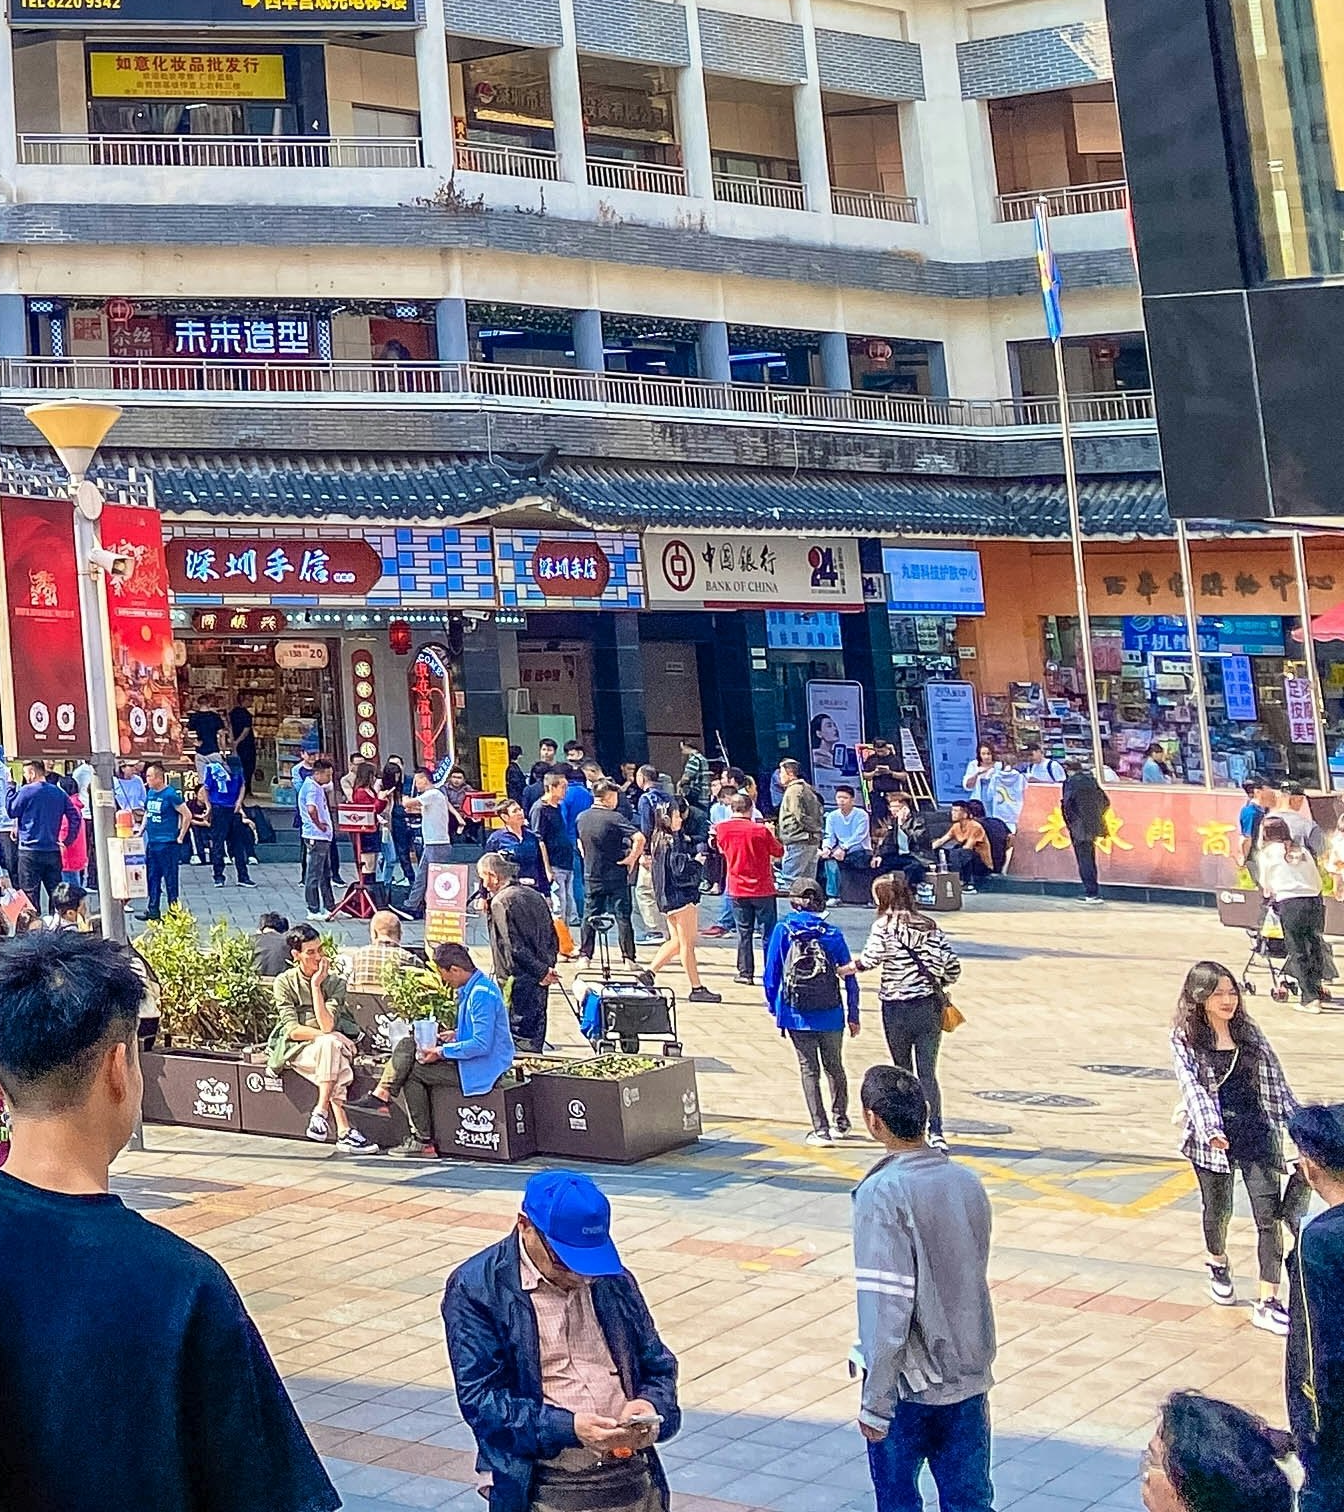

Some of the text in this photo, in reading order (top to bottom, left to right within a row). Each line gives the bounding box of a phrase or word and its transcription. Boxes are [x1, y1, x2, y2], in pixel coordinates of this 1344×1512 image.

[115, 55, 260, 73] 如意化妆品批发行
[175, 319, 309, 354] 未来造型
[185, 547, 330, 583] 深圳手信
[538, 553, 598, 580] 深圳手信
[705, 581, 779, 594] BANK OF CHINA
